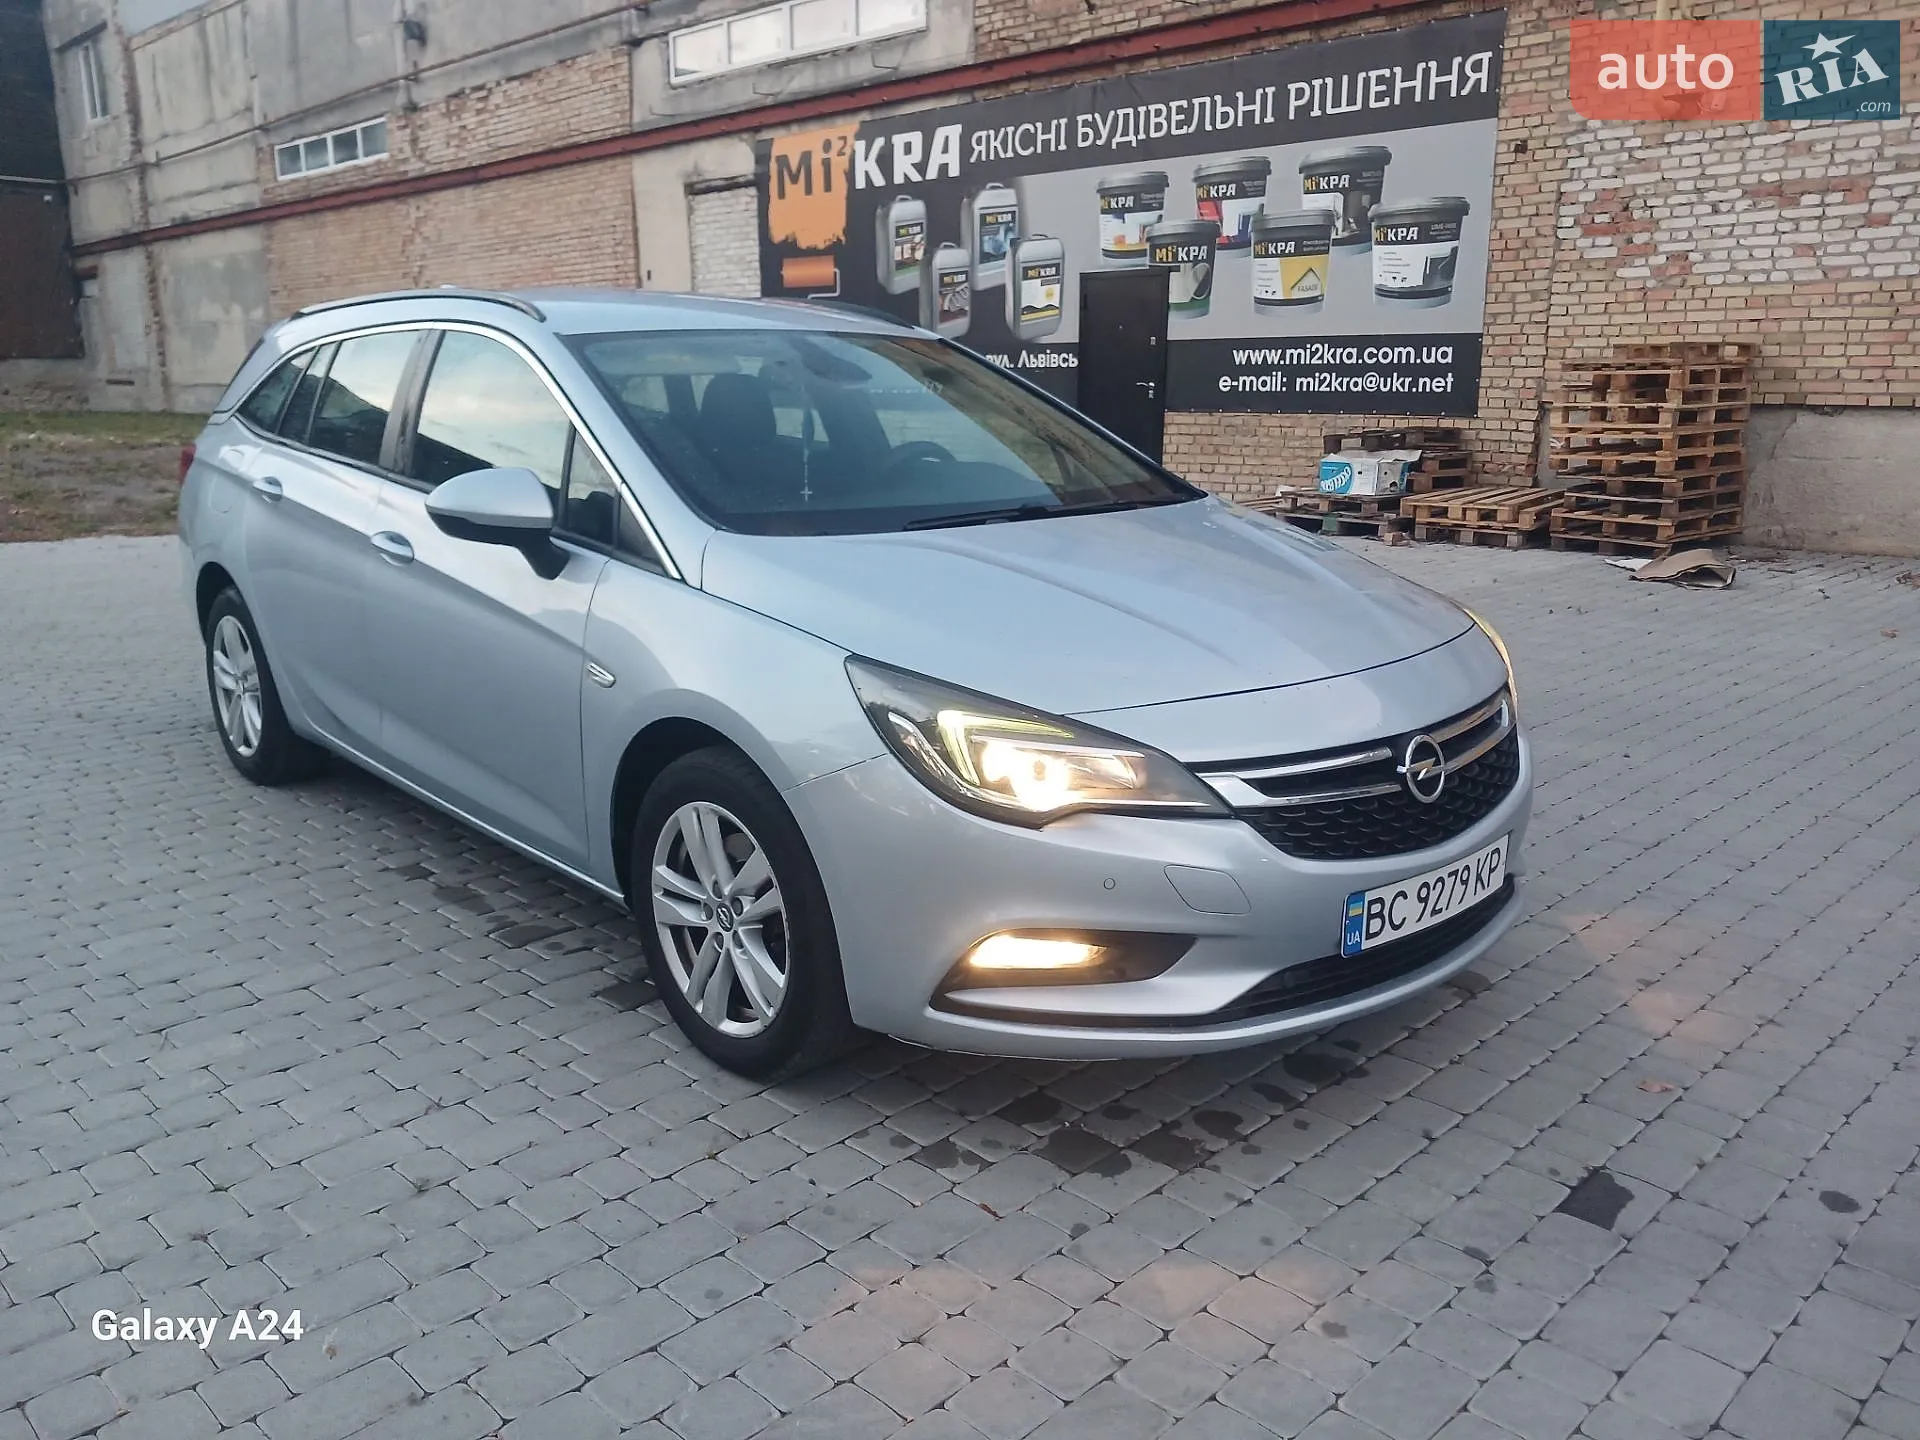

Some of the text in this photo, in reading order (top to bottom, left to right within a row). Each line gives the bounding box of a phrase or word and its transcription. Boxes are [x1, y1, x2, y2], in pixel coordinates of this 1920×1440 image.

[969, 51, 1493, 164] ЯКІСНІ БУДІВЕЛЬНІ РІШЕННЯ
[1232, 343, 1453, 366] www.mi2kra.com.ua
[1218, 371, 1454, 393] e-mail: mi2kra@ukr.net
[1365, 847, 1501, 941] BC 9279 KP
[1347, 932, 1361, 946] UA
